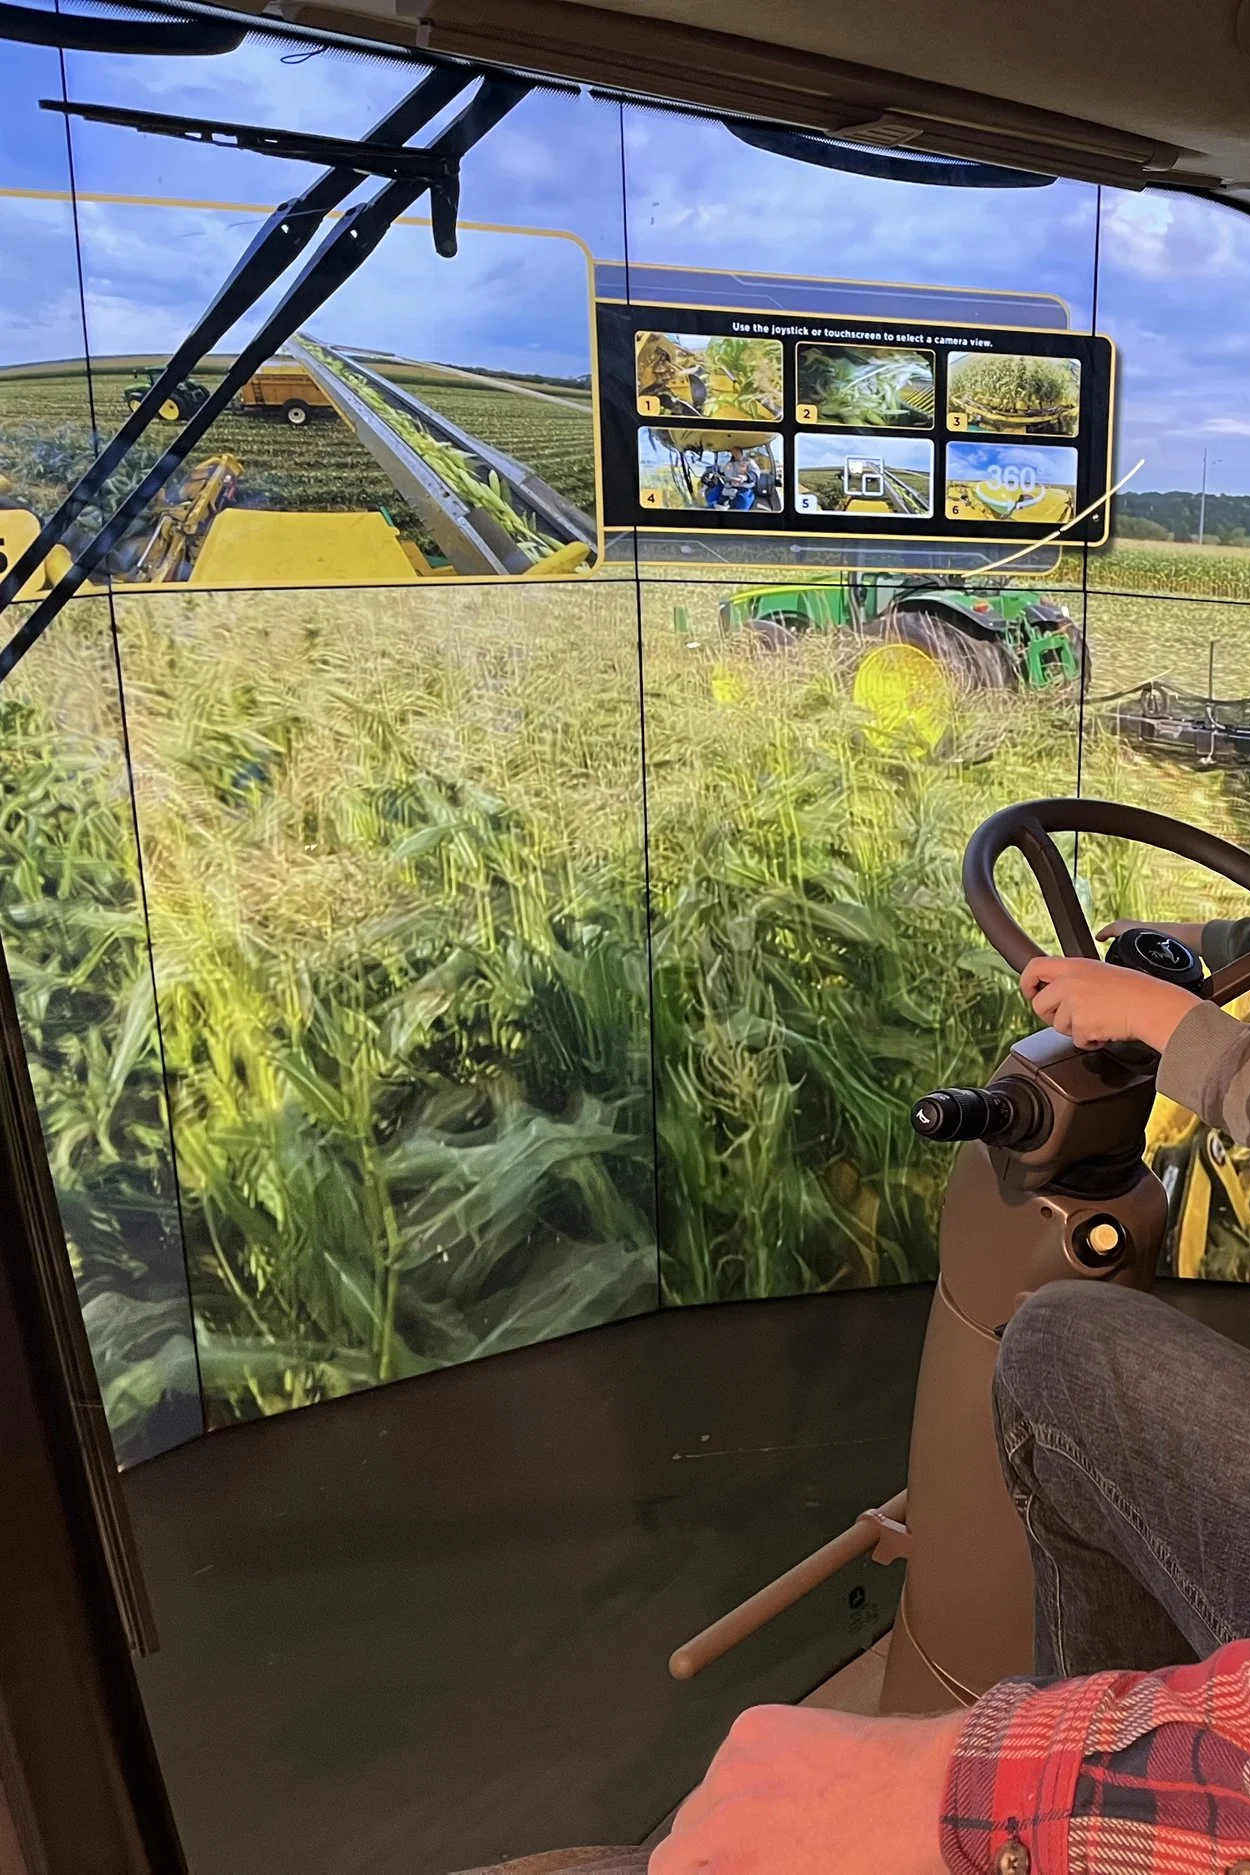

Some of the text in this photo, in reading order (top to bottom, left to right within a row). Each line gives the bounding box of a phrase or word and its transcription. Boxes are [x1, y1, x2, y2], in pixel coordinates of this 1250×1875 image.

[732, 322, 993, 348] Use the joystick or touchscreen to select a camera view.
[803, 409, 811, 419] 2
[953, 417, 960, 427] 3
[647, 493, 655, 503] 4
[802, 499, 809, 508] 5
[953, 506, 960, 515] 6
